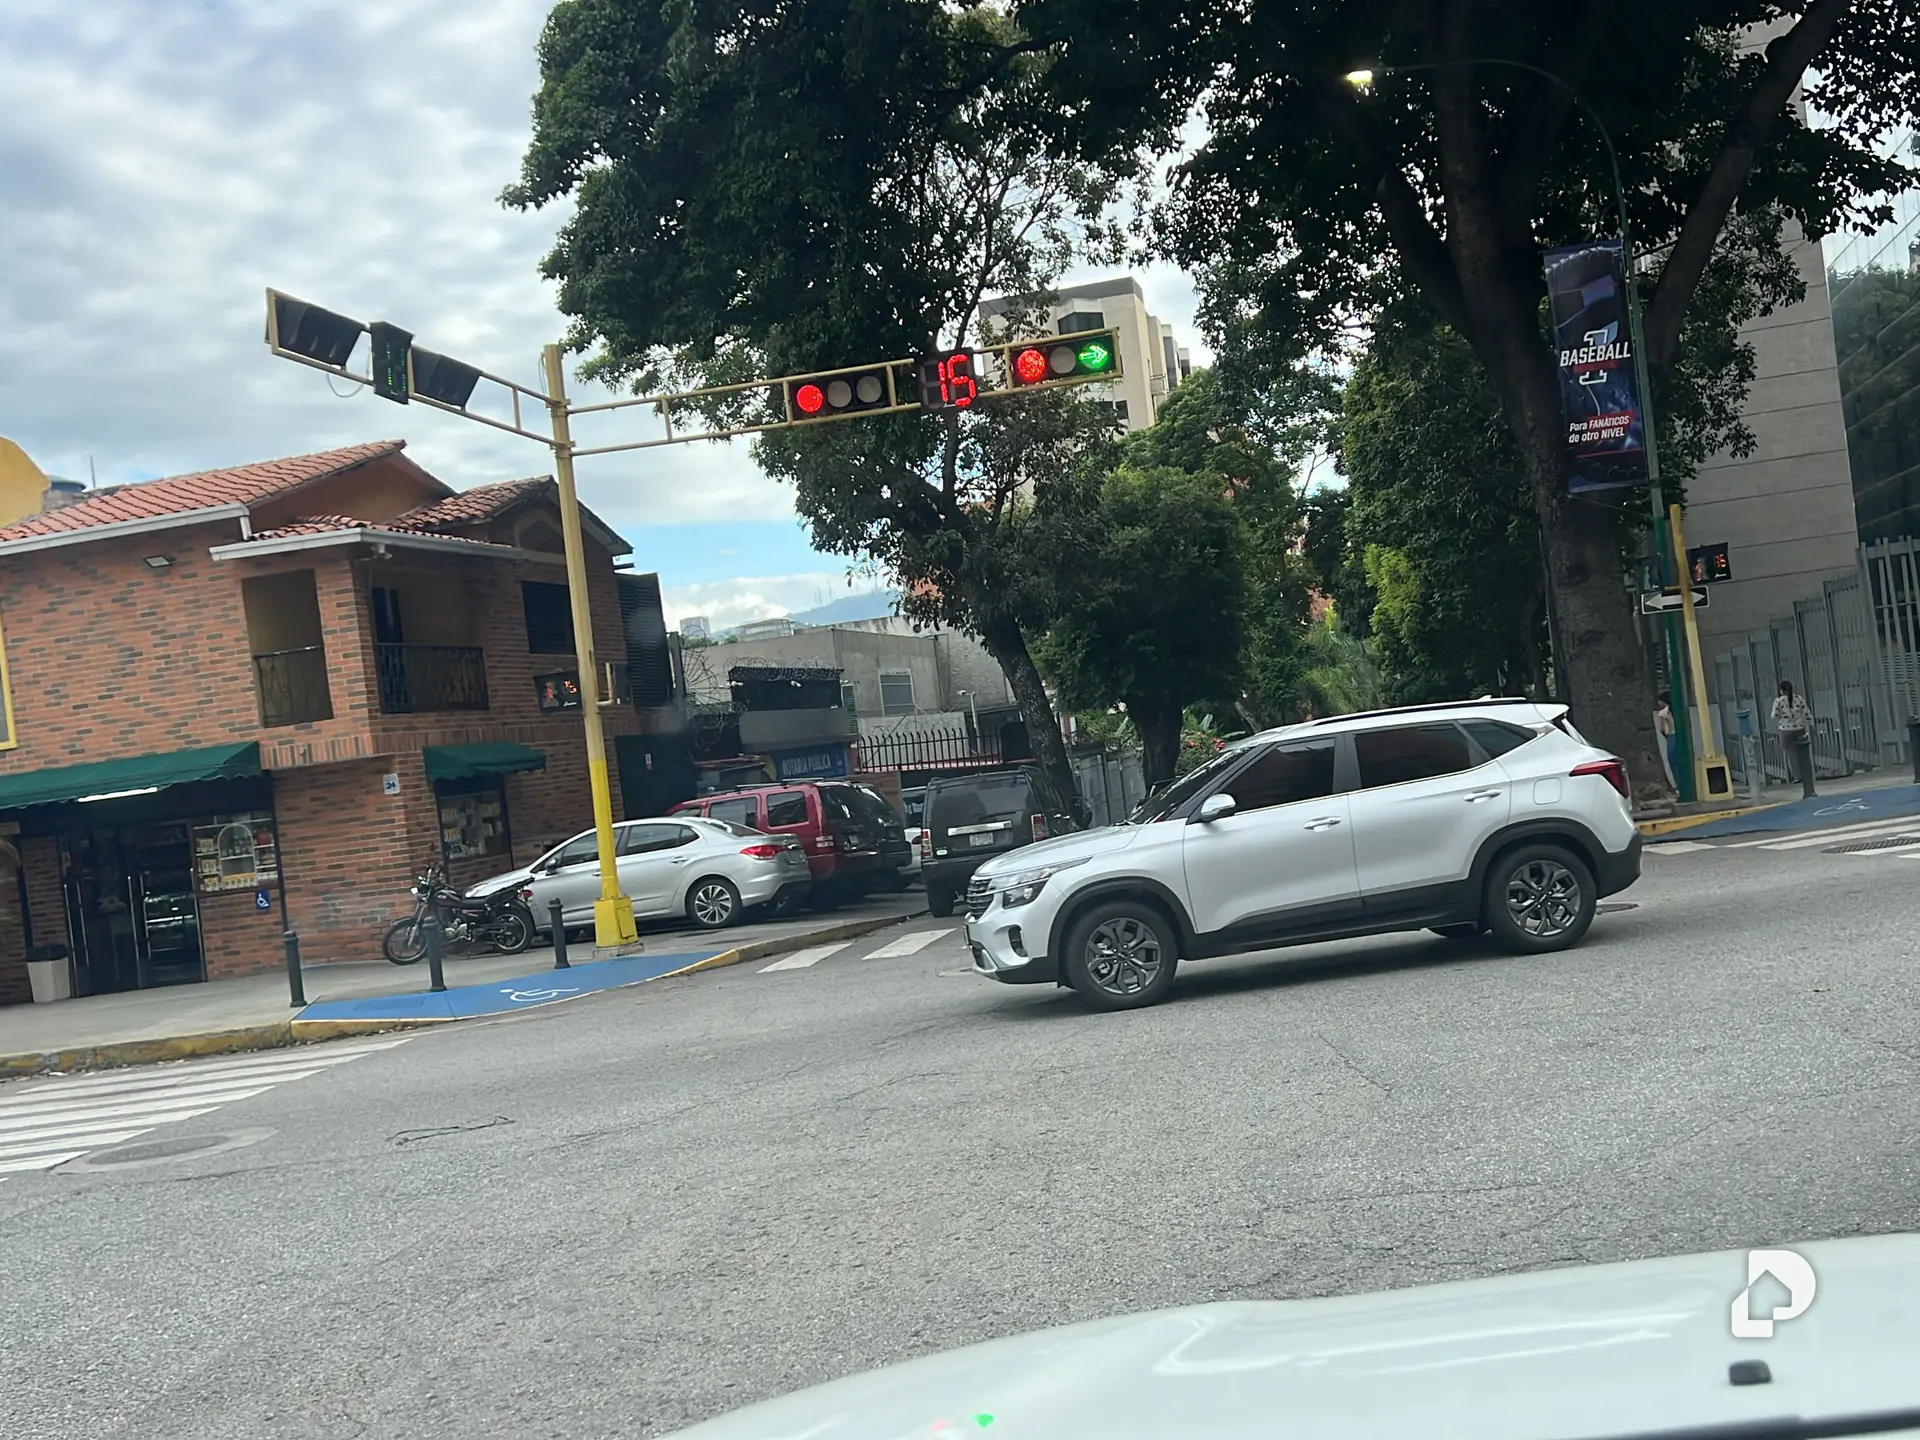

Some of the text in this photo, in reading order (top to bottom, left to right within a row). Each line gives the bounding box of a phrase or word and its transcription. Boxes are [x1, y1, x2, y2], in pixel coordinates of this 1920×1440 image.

[1560, 341, 1631, 367] BASEBALL
[937, 353, 977, 406] 15
[1568, 427, 1625, 443] de otro NIVEL
[1569, 422, 1587, 432] Para
